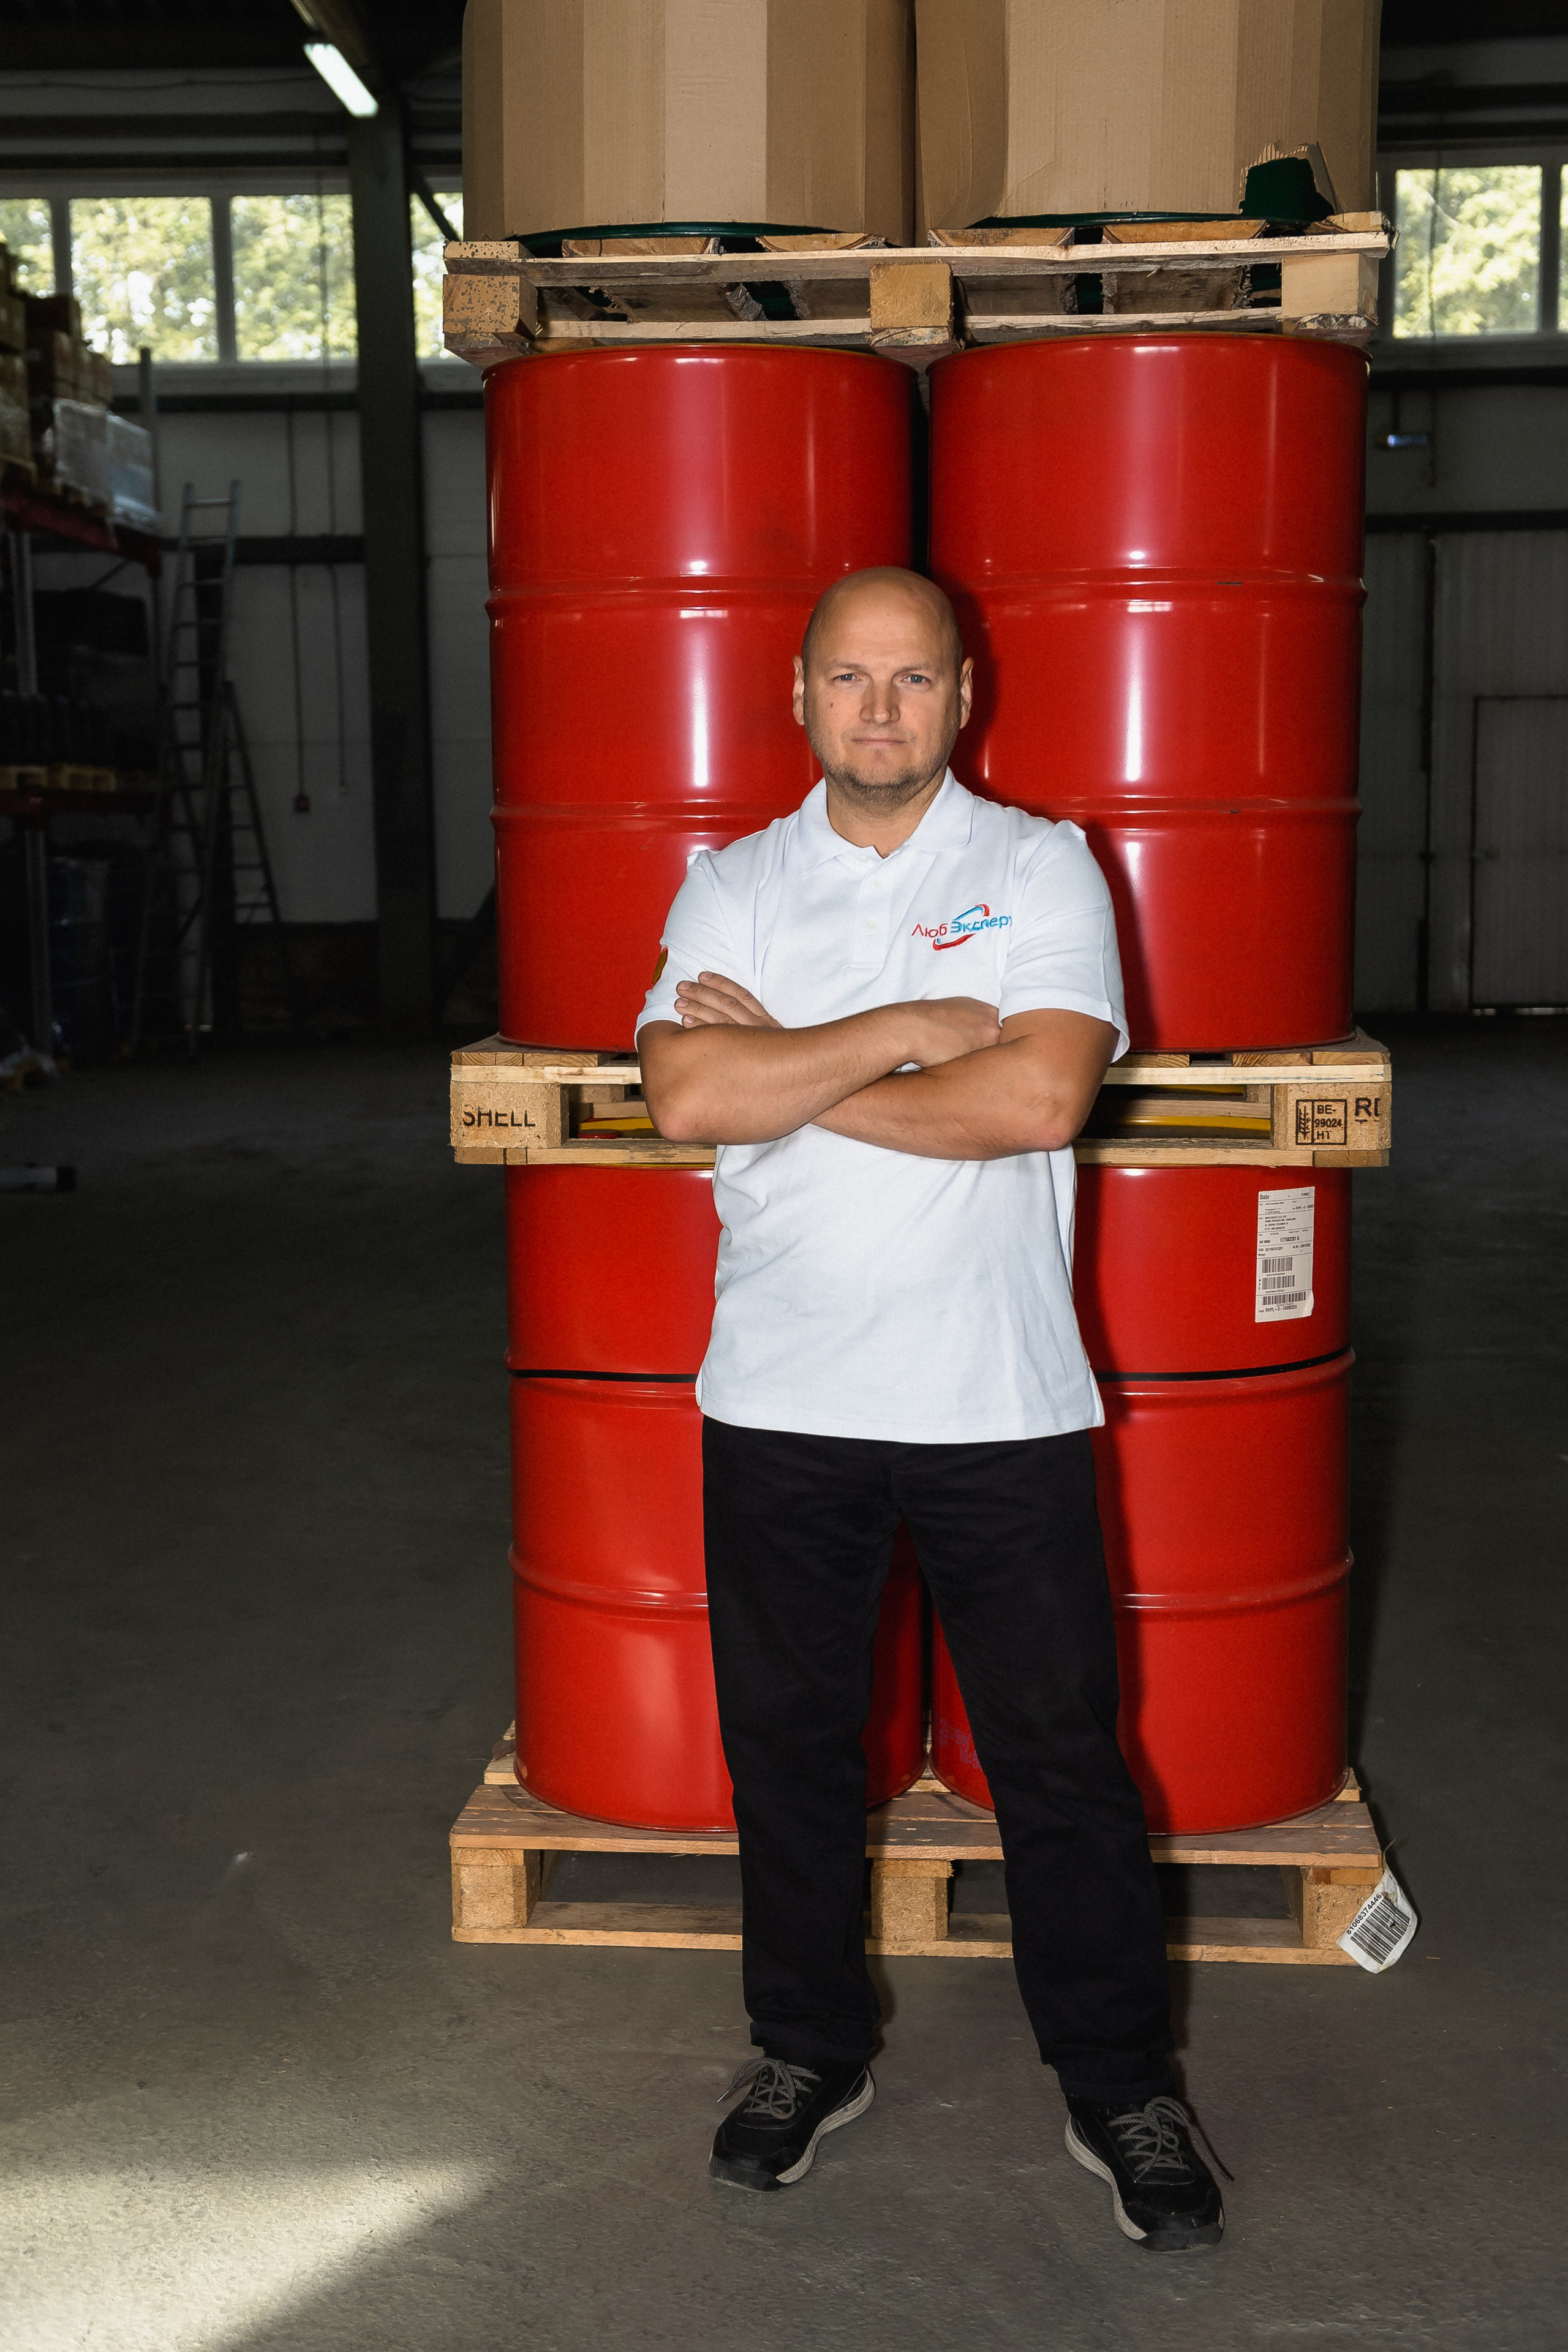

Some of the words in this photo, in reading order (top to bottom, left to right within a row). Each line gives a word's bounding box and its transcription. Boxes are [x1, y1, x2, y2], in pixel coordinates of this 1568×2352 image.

[1317, 1104, 1336, 1114] BE-
[462, 1104, 536, 1127] SHELL
[1314, 1118, 1342, 1128] 99024
[1317, 1131, 1332, 1140] HT
[1346, 1893, 1382, 1935] 81068374446
